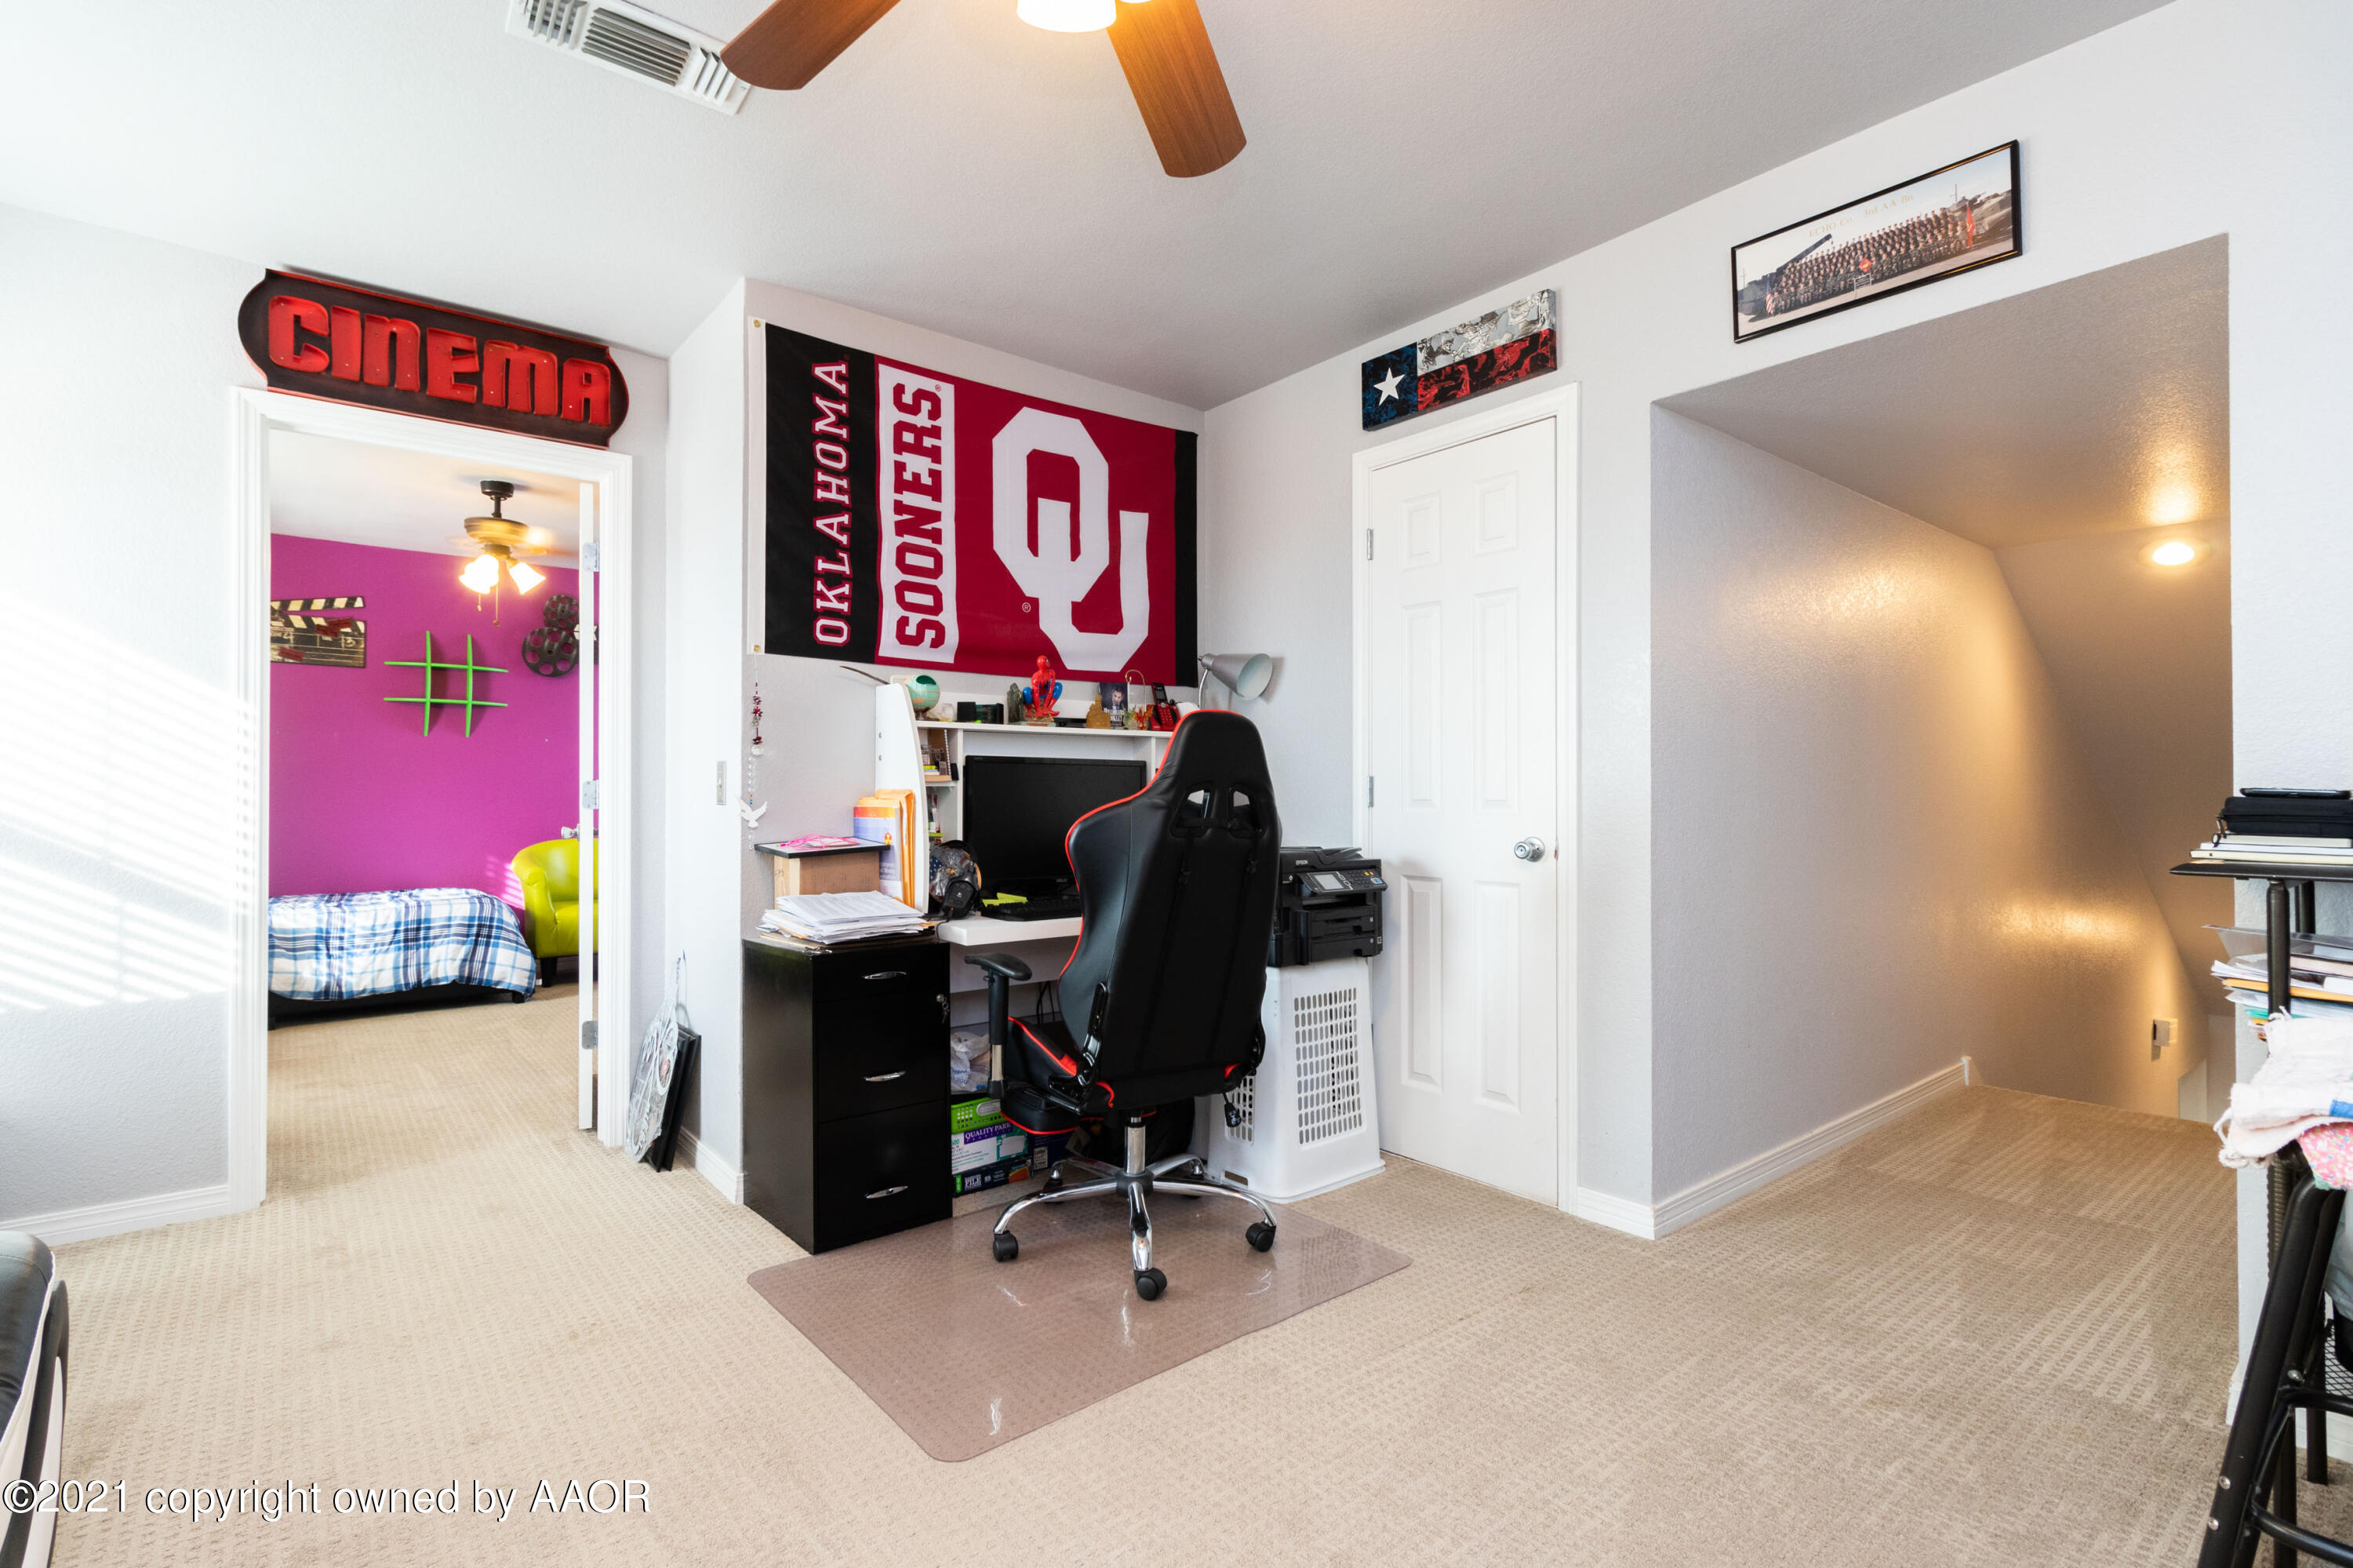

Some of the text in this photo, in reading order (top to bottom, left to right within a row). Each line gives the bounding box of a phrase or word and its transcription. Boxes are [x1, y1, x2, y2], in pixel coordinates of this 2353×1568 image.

[268, 295, 611, 427] CINEMA
[813, 358, 853, 647] OKLAHOMA
[893, 382, 946, 649] SOONERS
[992, 406, 1149, 672] OU
[965, 1127, 994, 1140] QUALITY
[995, 1122, 1012, 1131] PARK
